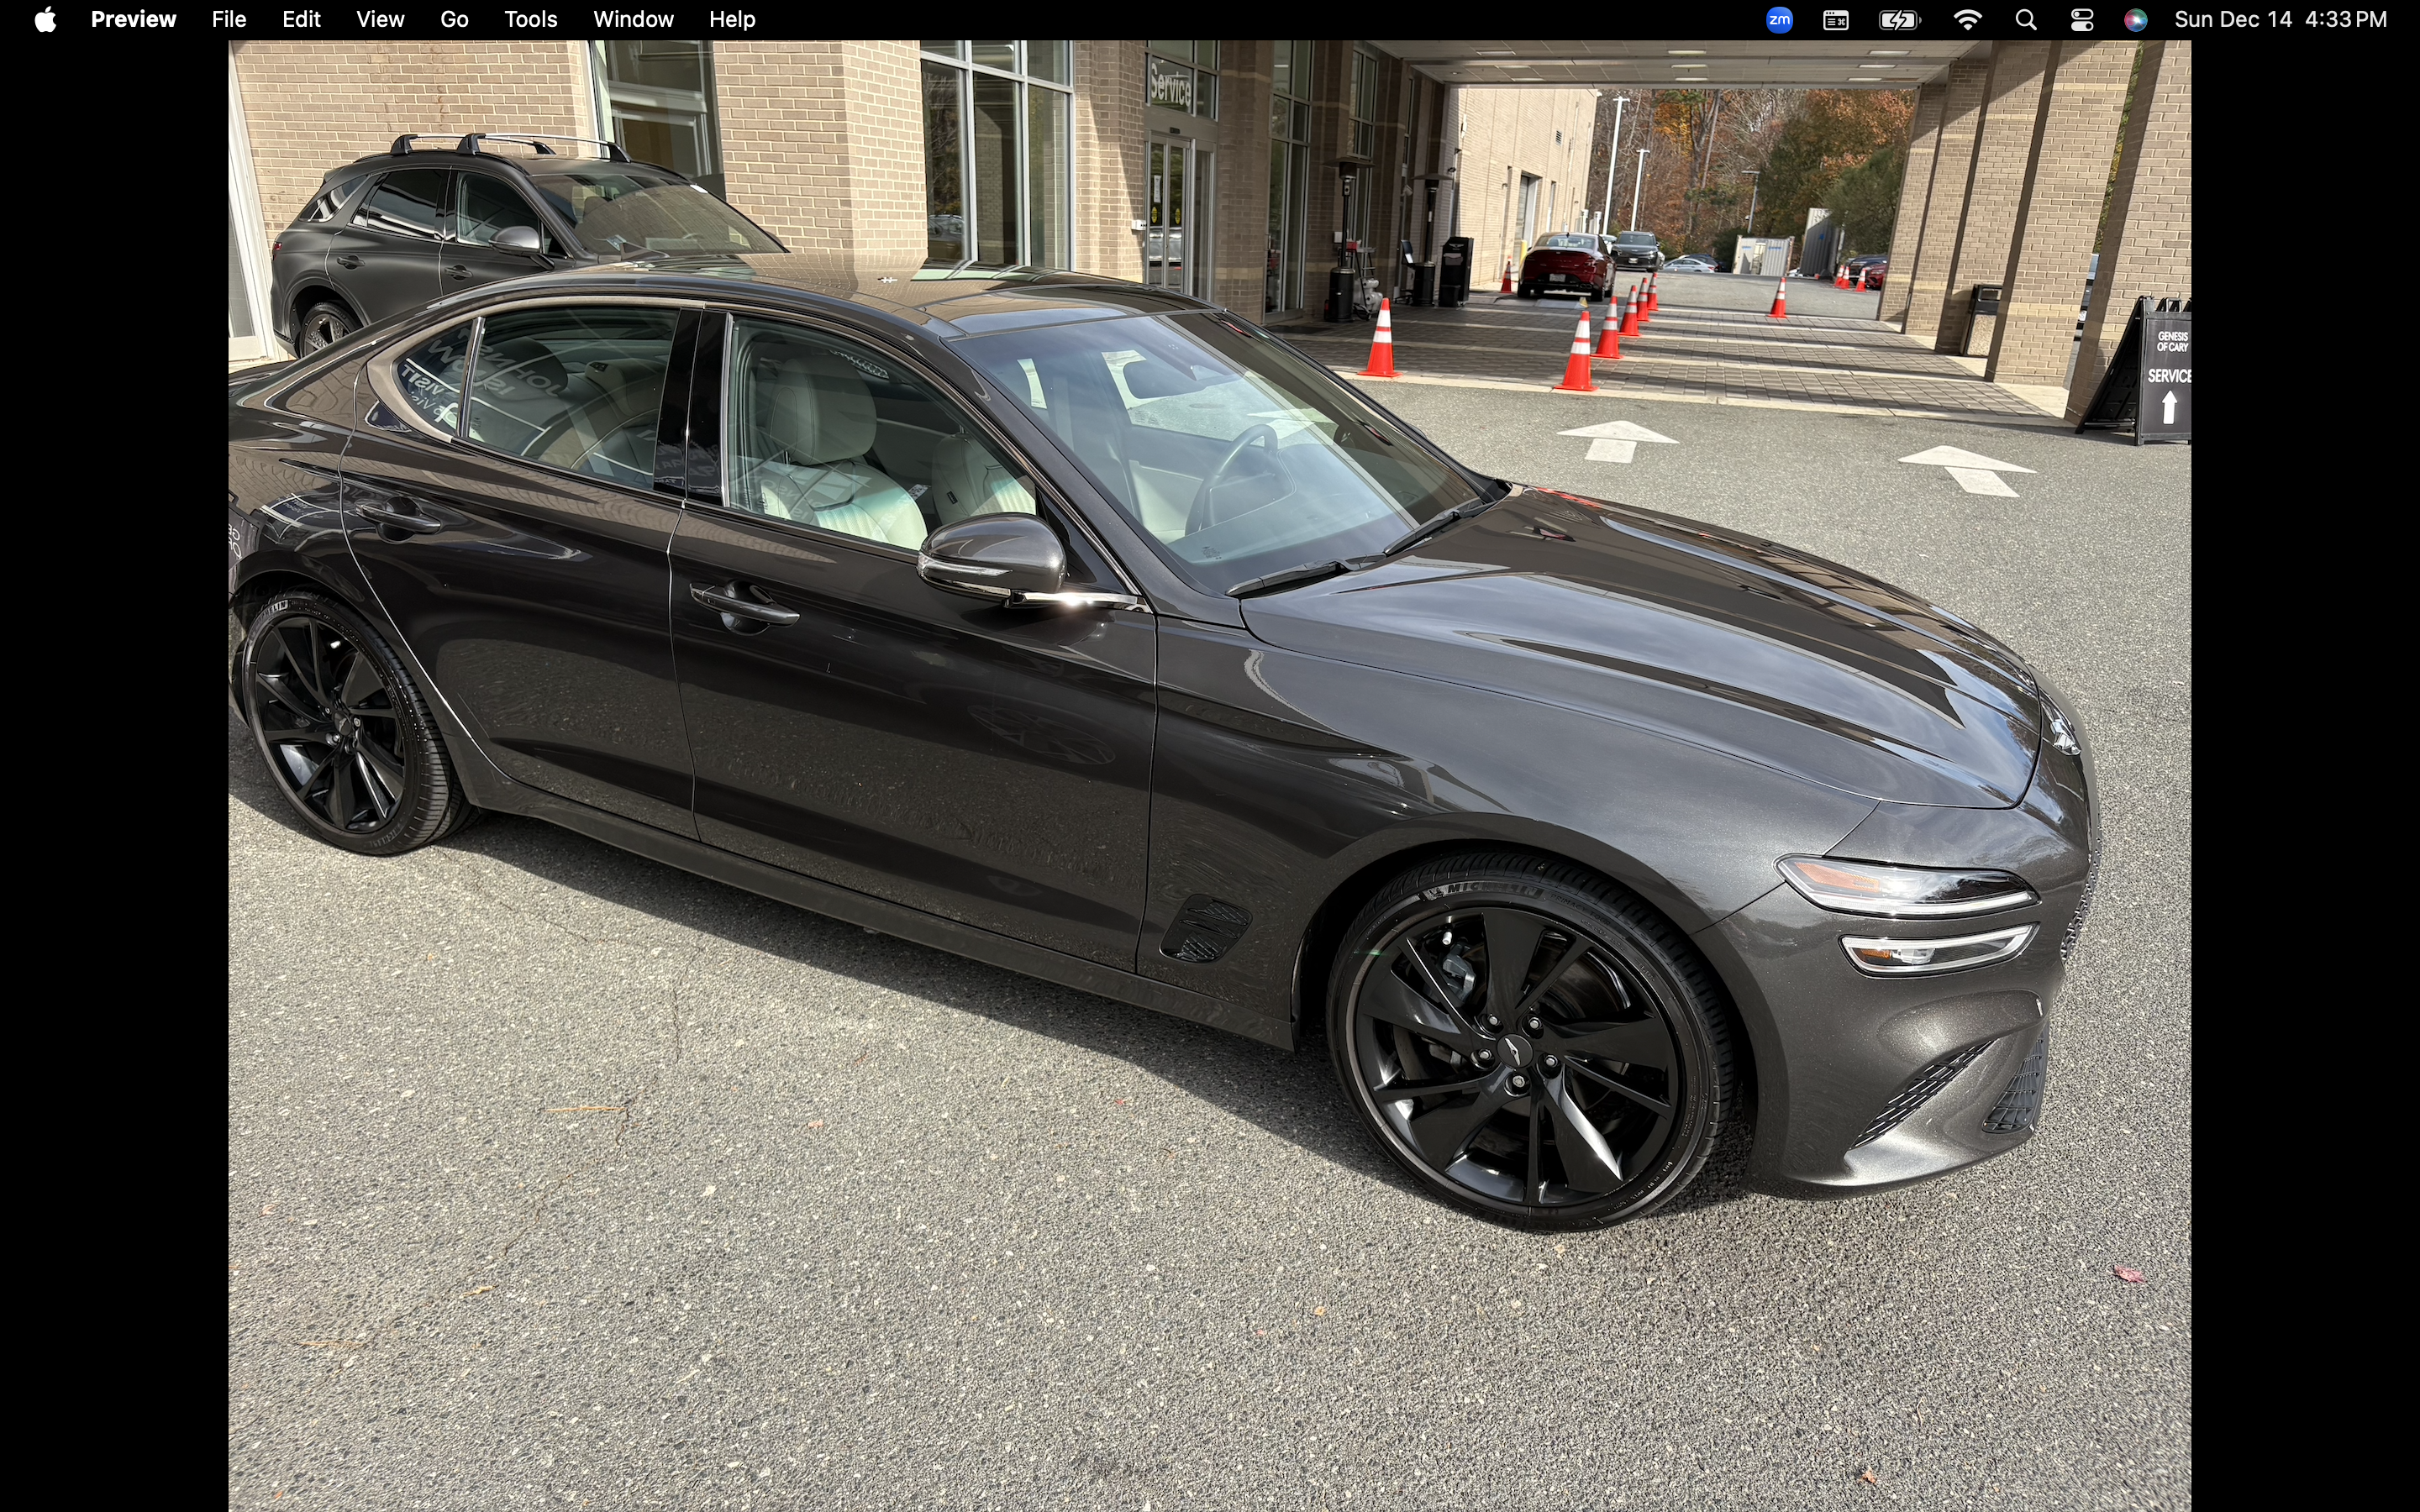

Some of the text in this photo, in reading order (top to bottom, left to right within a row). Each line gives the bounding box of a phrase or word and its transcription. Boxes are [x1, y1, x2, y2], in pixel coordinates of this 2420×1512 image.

[1150, 62, 1192, 107] Service
[2158, 331, 2189, 342] GENESIS
[2157, 342, 2189, 353] OF CARY
[2147, 368, 2191, 383] SERVICE
[1448, 881, 1537, 897] MICHELIN
